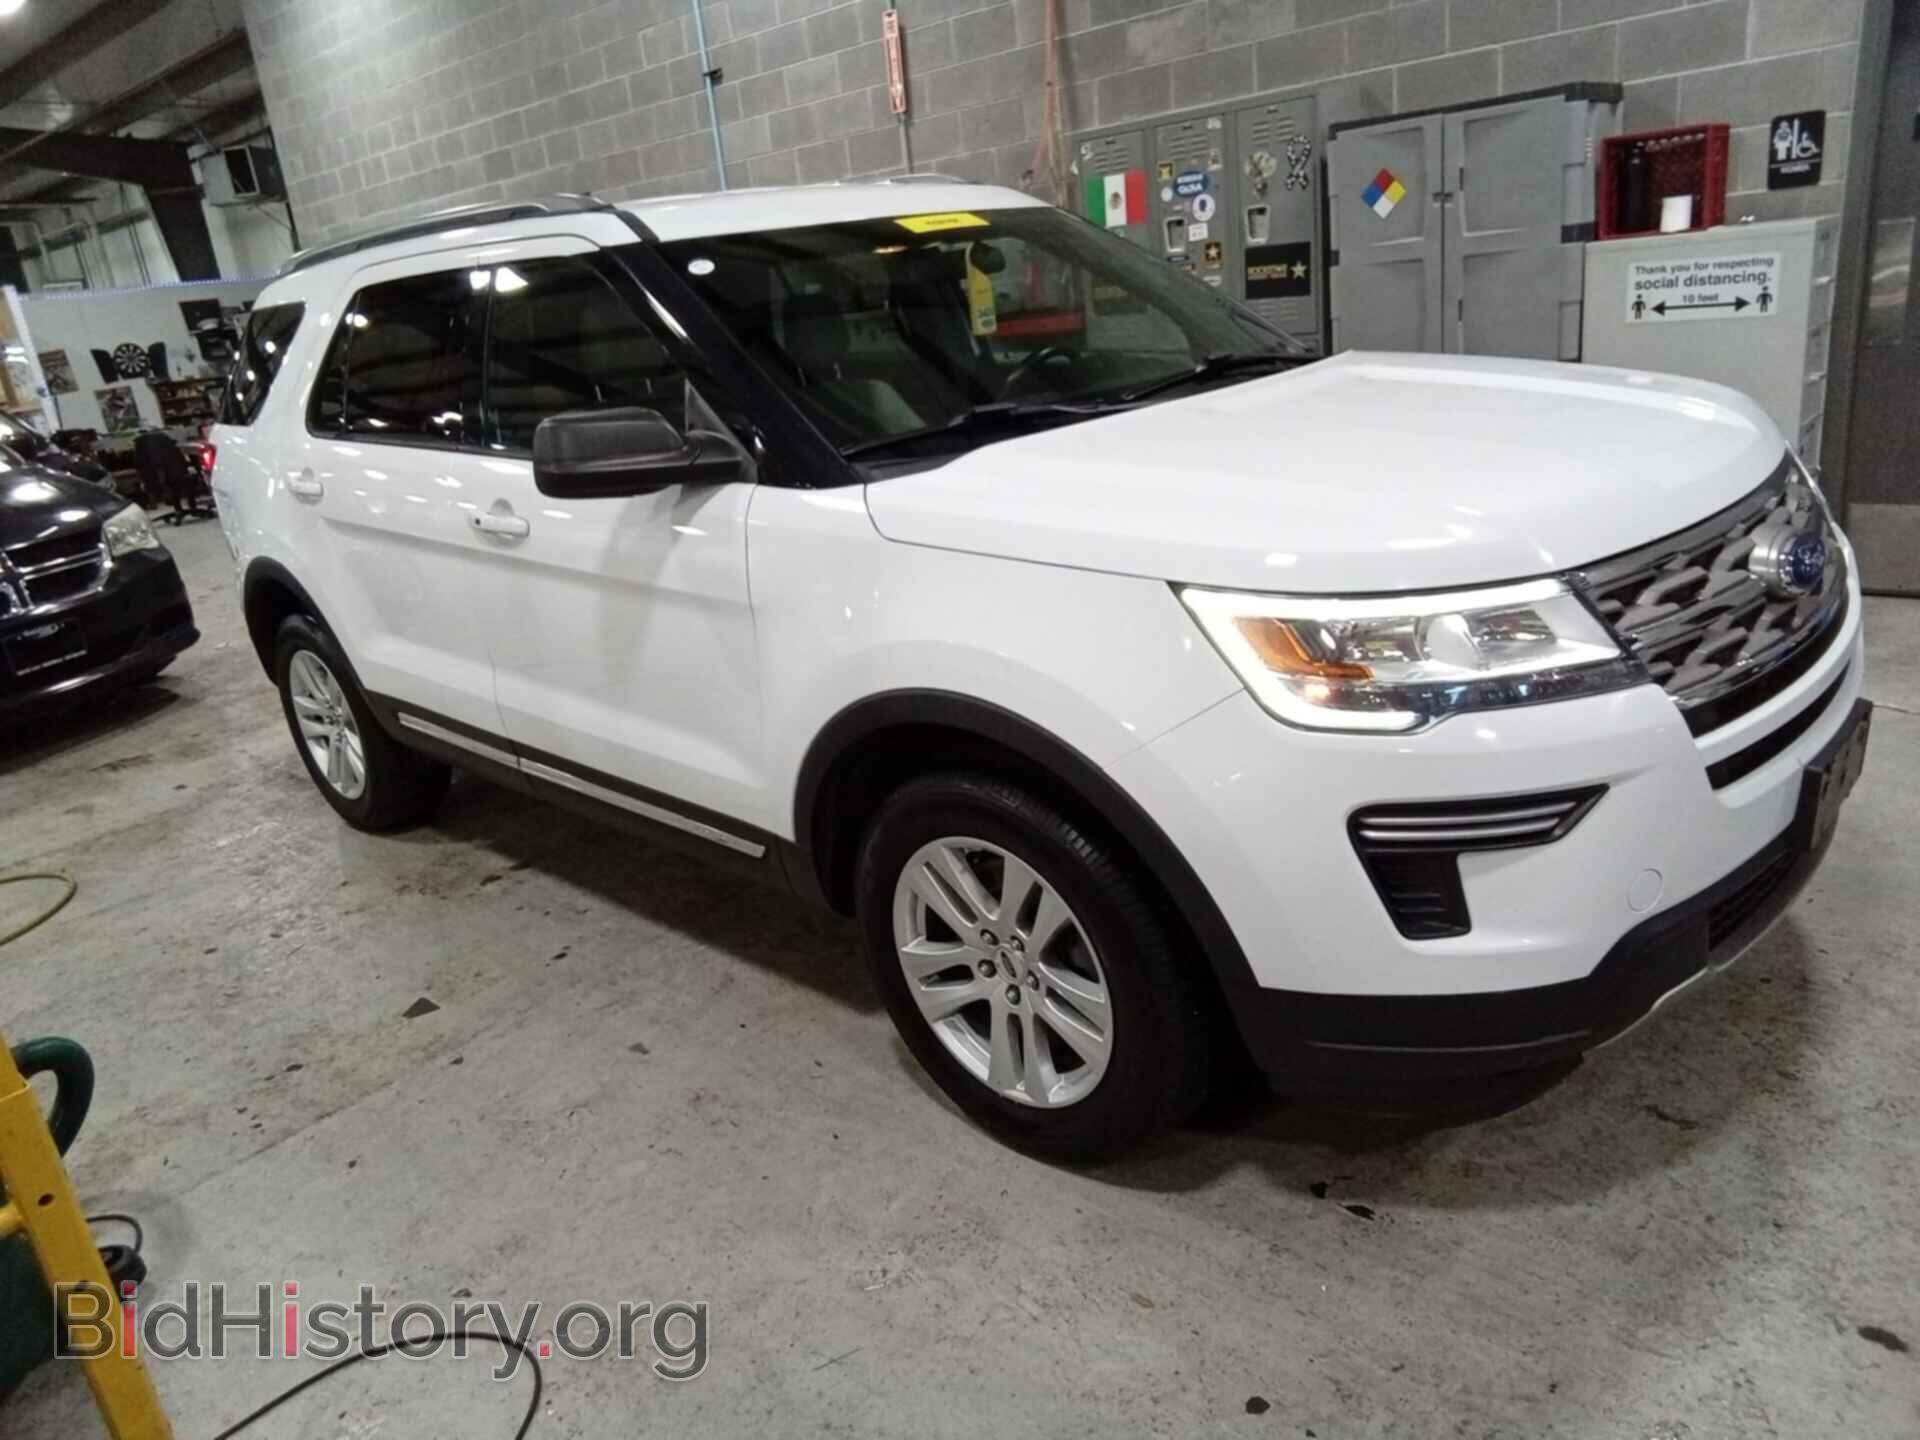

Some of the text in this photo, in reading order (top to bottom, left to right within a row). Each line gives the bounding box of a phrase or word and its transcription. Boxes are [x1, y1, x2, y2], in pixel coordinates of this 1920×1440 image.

[1634, 257, 1774, 274] Thank you for respecting
[1634, 271, 1772, 290] social distancing.
[1682, 293, 1719, 303] 10 feet
